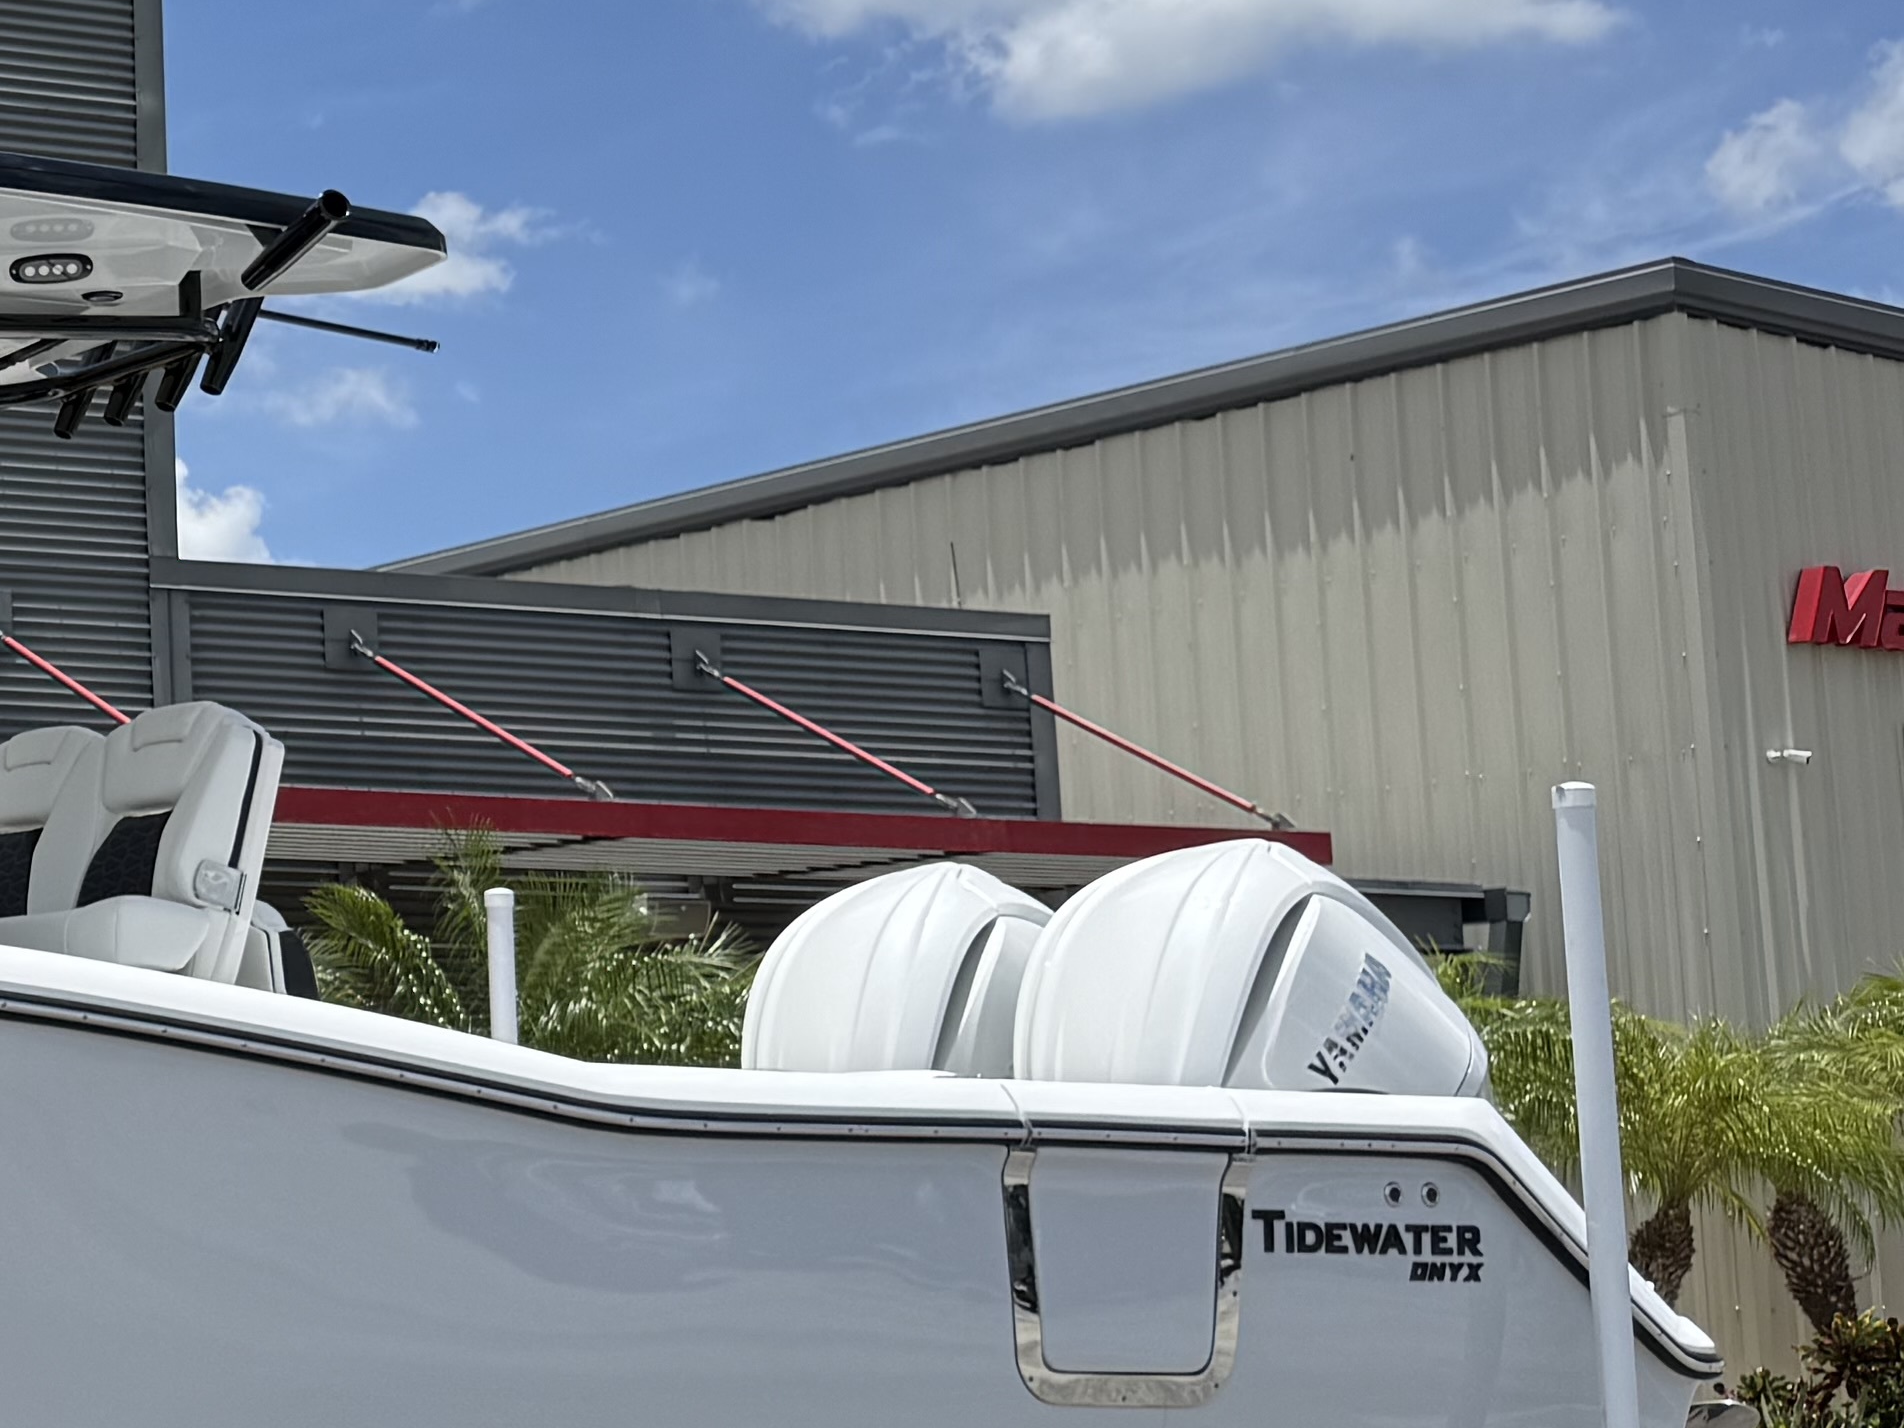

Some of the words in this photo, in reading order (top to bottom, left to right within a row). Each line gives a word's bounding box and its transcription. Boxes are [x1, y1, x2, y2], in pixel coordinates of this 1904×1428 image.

[1307, 952, 1392, 1085] YAMAHA
[1251, 1209, 1484, 1257] TIDEWATER
[1409, 1261, 1484, 1283] ONYX
